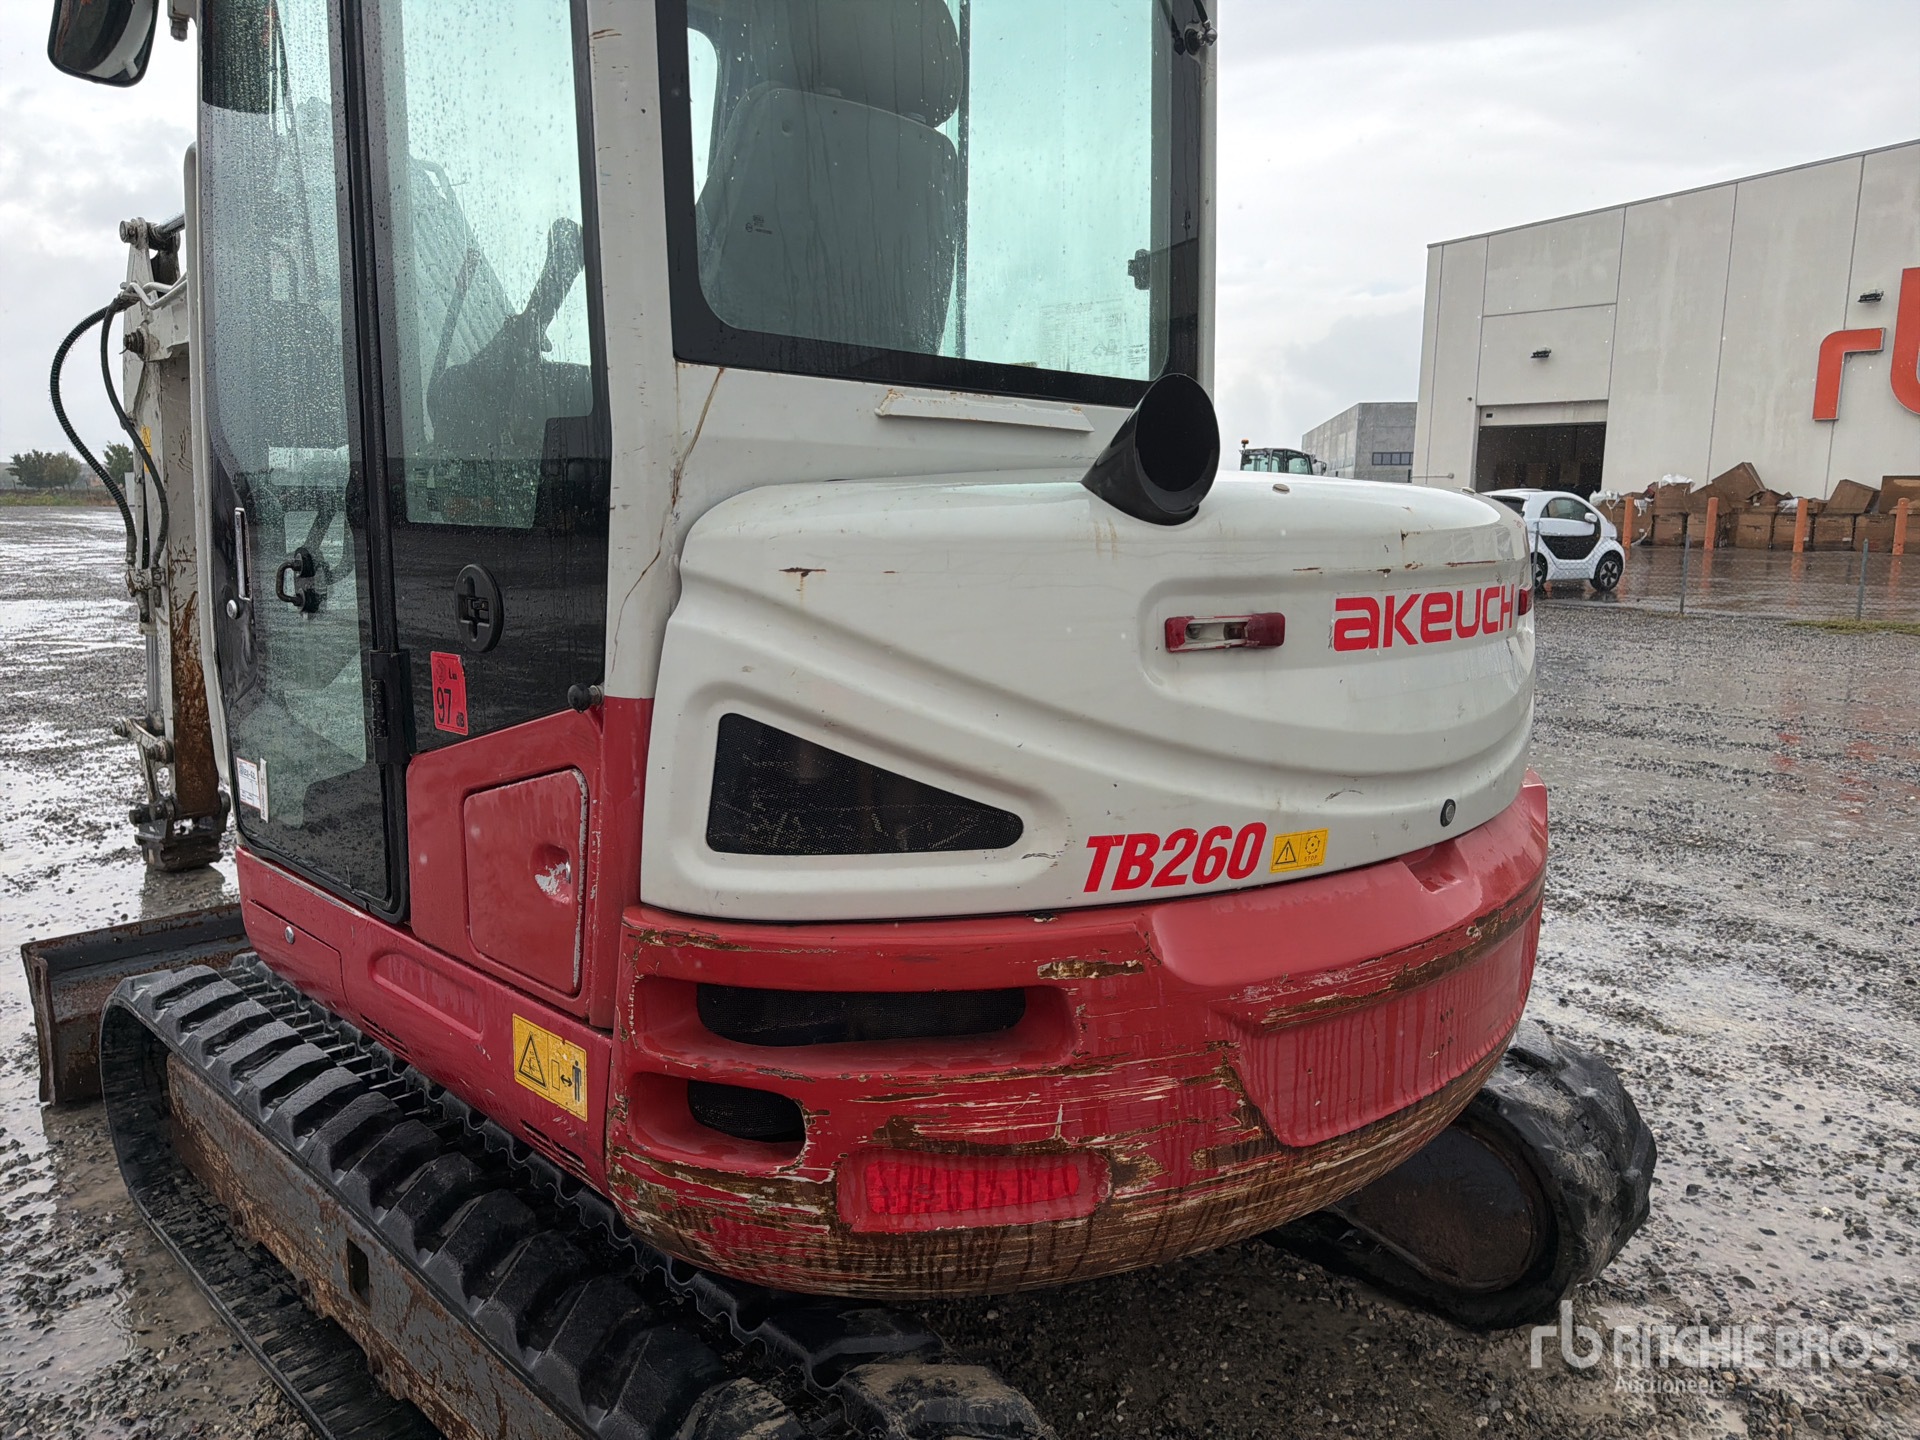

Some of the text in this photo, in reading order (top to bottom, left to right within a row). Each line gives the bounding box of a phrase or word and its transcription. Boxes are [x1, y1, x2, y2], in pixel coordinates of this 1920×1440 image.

[1812, 267, 1920, 421] r
[436, 686, 452, 724] 97
[1083, 821, 1267, 893] TB260
[1303, 855, 1318, 863] STOP
